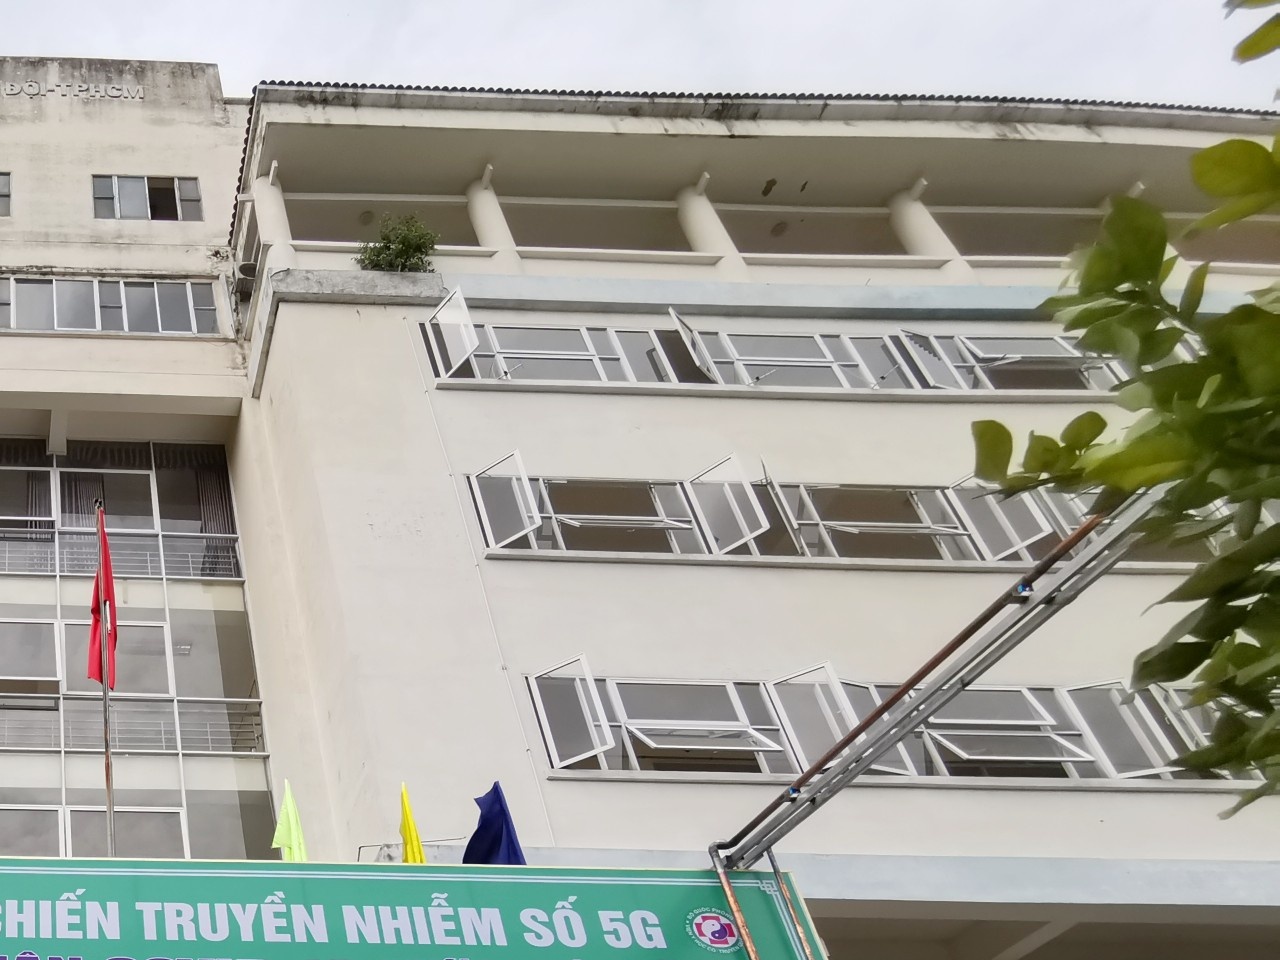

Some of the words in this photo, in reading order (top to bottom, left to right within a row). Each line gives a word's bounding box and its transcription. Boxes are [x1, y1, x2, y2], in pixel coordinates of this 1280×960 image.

[135, 891, 329, 943] TRUYỀN
[341, 892, 508, 946] NHIỄM
[520, 895, 587, 948] SỐ
[597, 909, 668, 949] 5G
